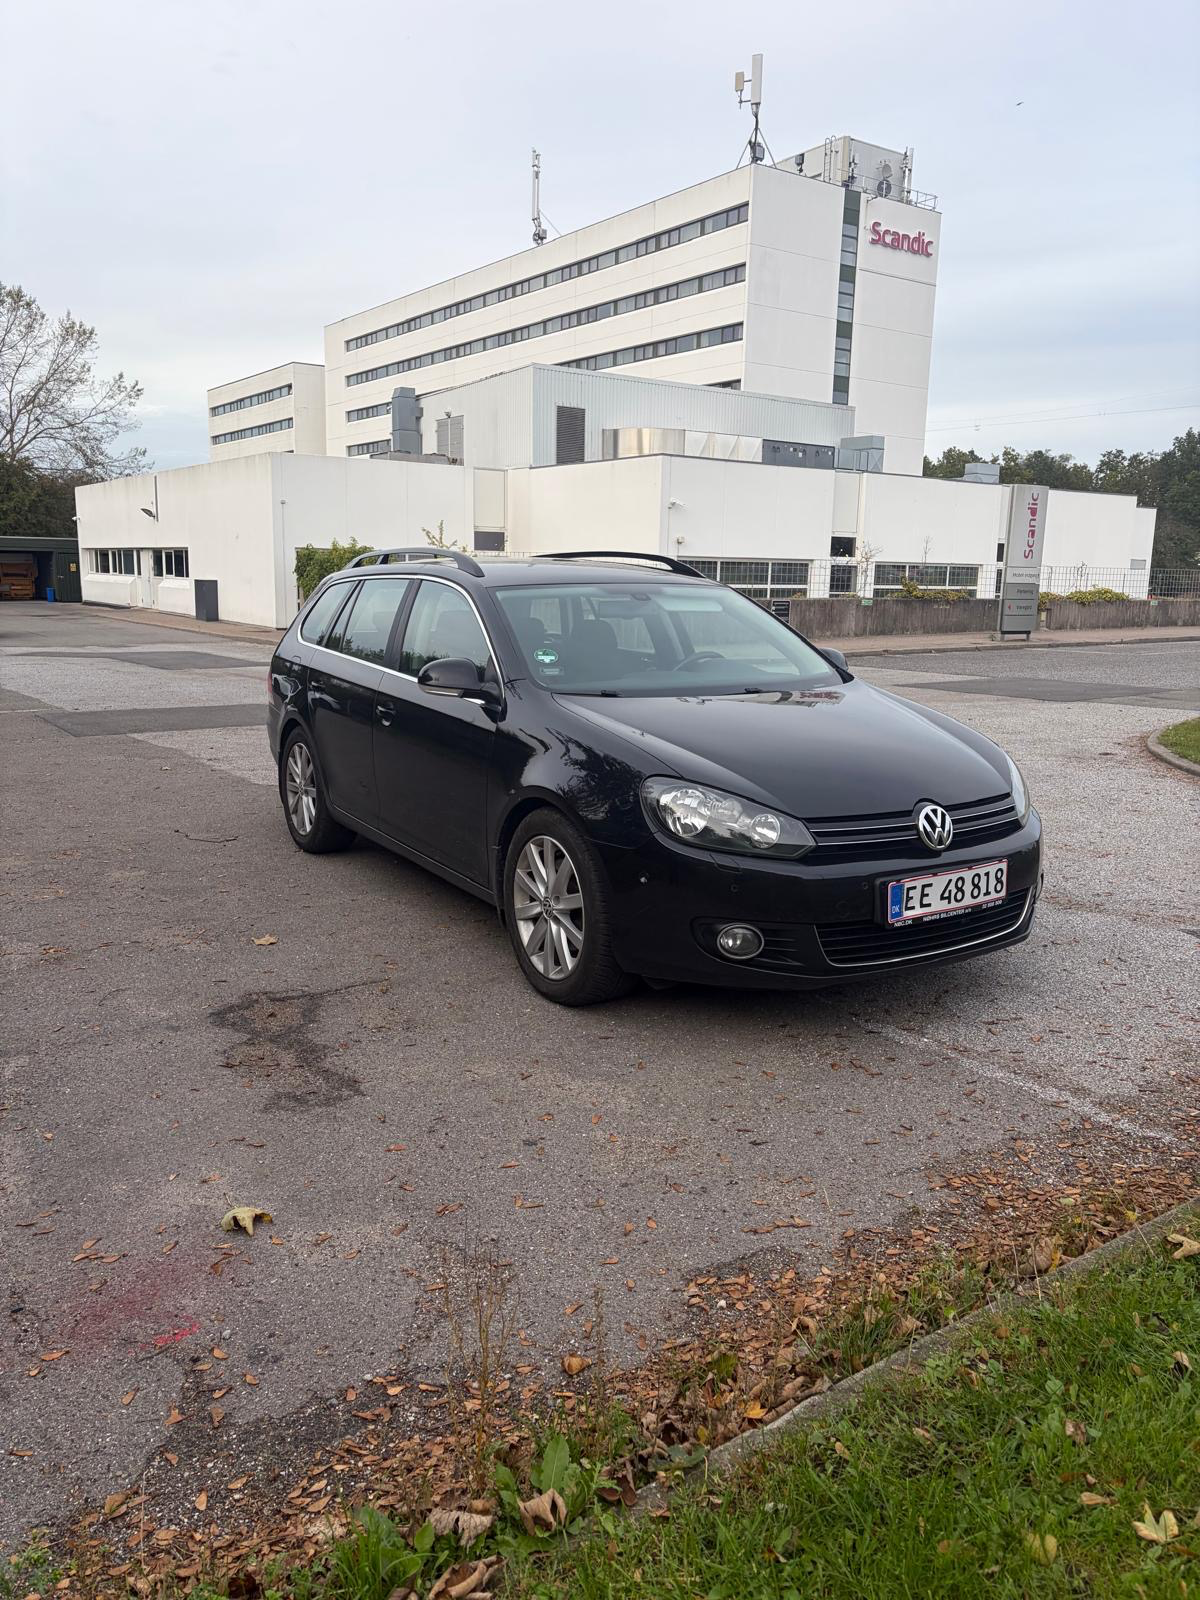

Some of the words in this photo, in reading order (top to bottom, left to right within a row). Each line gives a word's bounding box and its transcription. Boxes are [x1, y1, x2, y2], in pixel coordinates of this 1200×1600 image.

[869, 221, 933, 257] Scandic
[1023, 492, 1039, 559] Scandic
[892, 904, 900, 914] DK
[904, 883, 933, 911] EE
